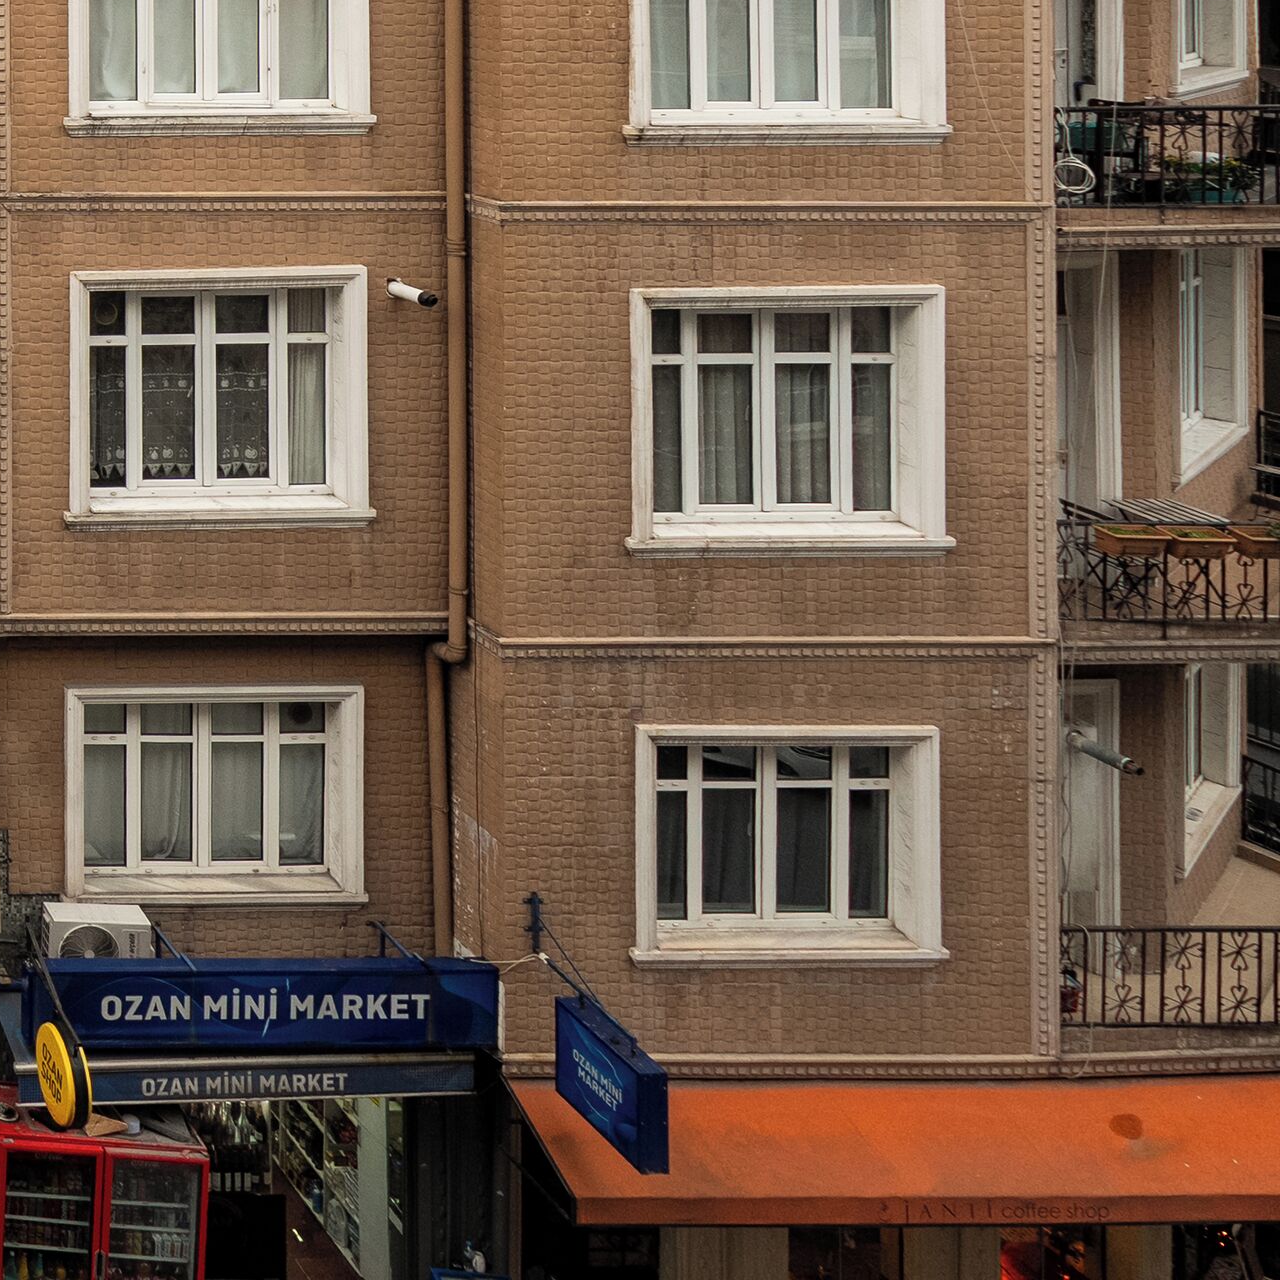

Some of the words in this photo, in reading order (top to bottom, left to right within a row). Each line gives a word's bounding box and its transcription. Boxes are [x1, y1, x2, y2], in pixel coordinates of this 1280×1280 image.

[101, 995, 191, 1021] OZAN
[204, 988, 278, 1020] MİNİ
[290, 994, 431, 1020] MARKET
[40, 1061, 62, 1104] SHOP
[42, 1042, 63, 1090] OZAN
[142, 1077, 199, 1096] OZAN
[206, 1070, 252, 1095] MİNİ
[259, 1073, 348, 1094] MARKET
[572, 1048, 599, 1079] OZAN
[600, 1074, 623, 1104] MİNİ
[578, 1066, 618, 1111] MARKET
[1001, 1202, 1061, 1219] coffee
[1067, 1202, 1111, 1221] shop
